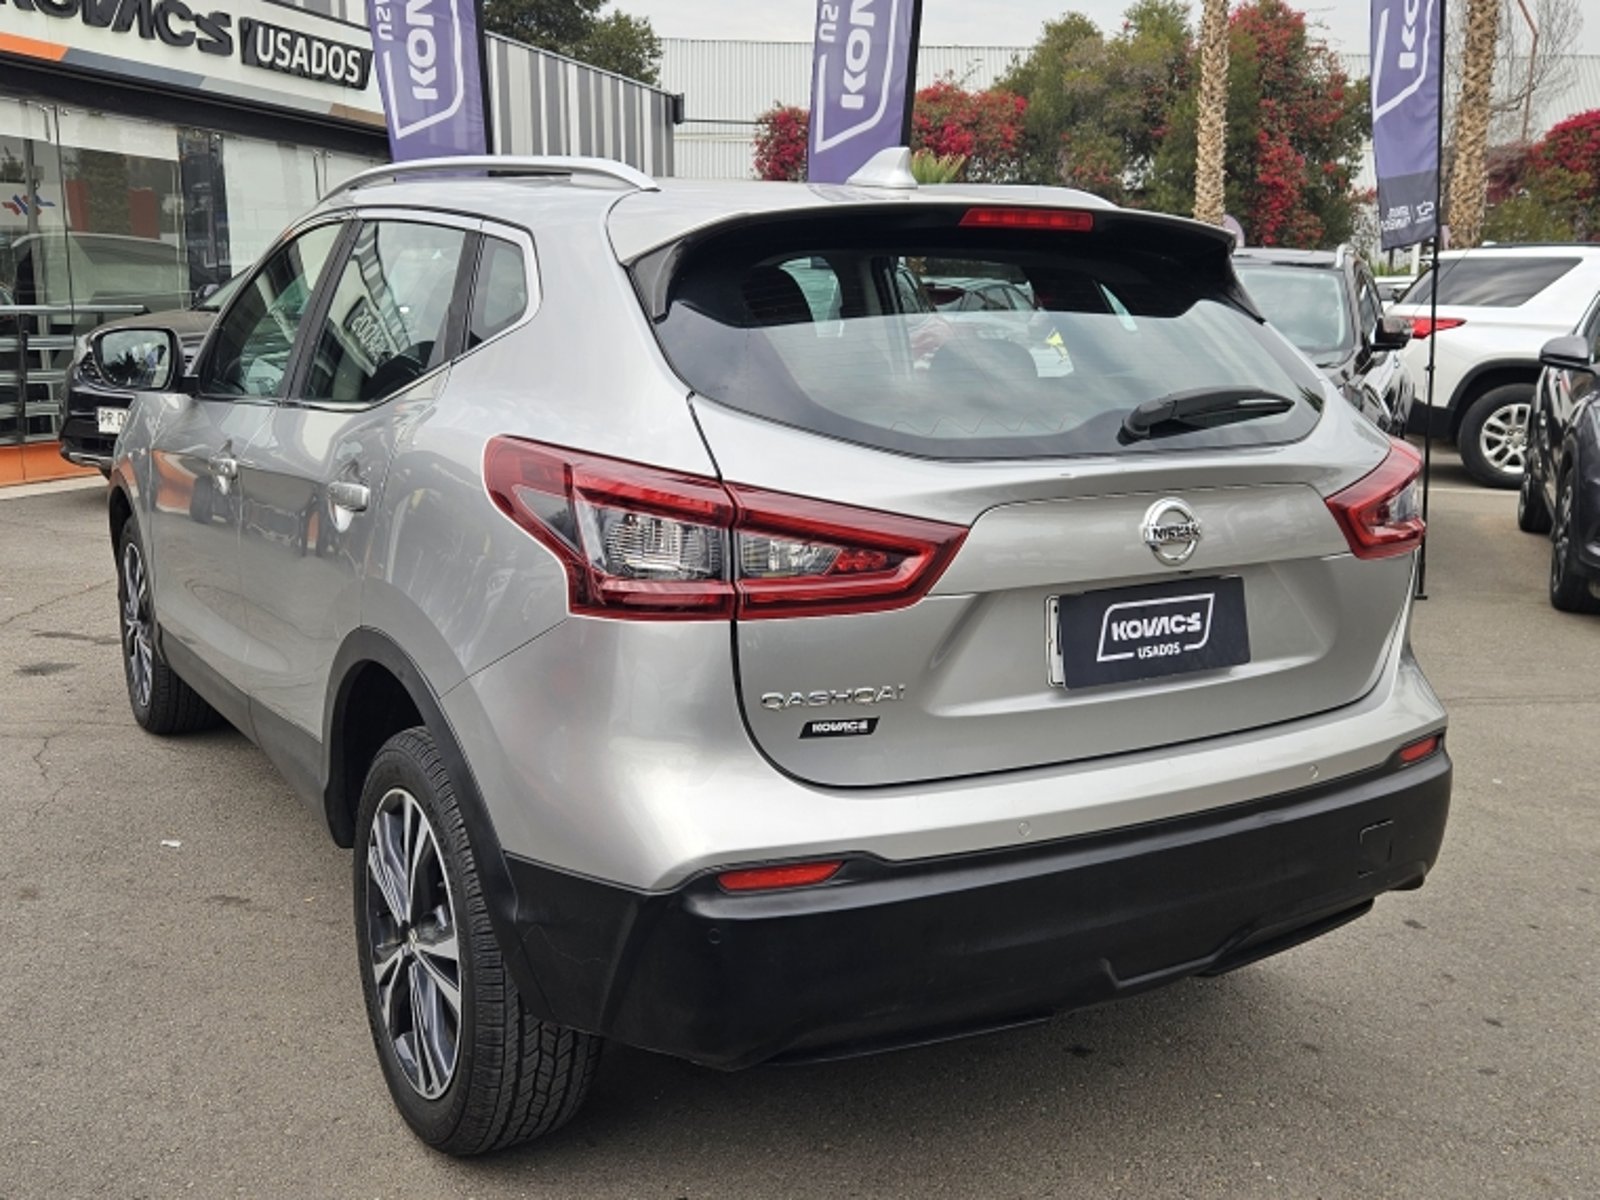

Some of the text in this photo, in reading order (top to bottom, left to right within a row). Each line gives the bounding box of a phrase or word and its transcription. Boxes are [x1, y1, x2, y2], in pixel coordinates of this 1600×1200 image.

[0, 0, 362, 84] VACS USADOS
[1111, 612, 1202, 641] KOVACS
[1137, 642, 1182, 659] USADOS
[760, 683, 906, 712] QASHQAI
[812, 720, 869, 734] KOVACS
